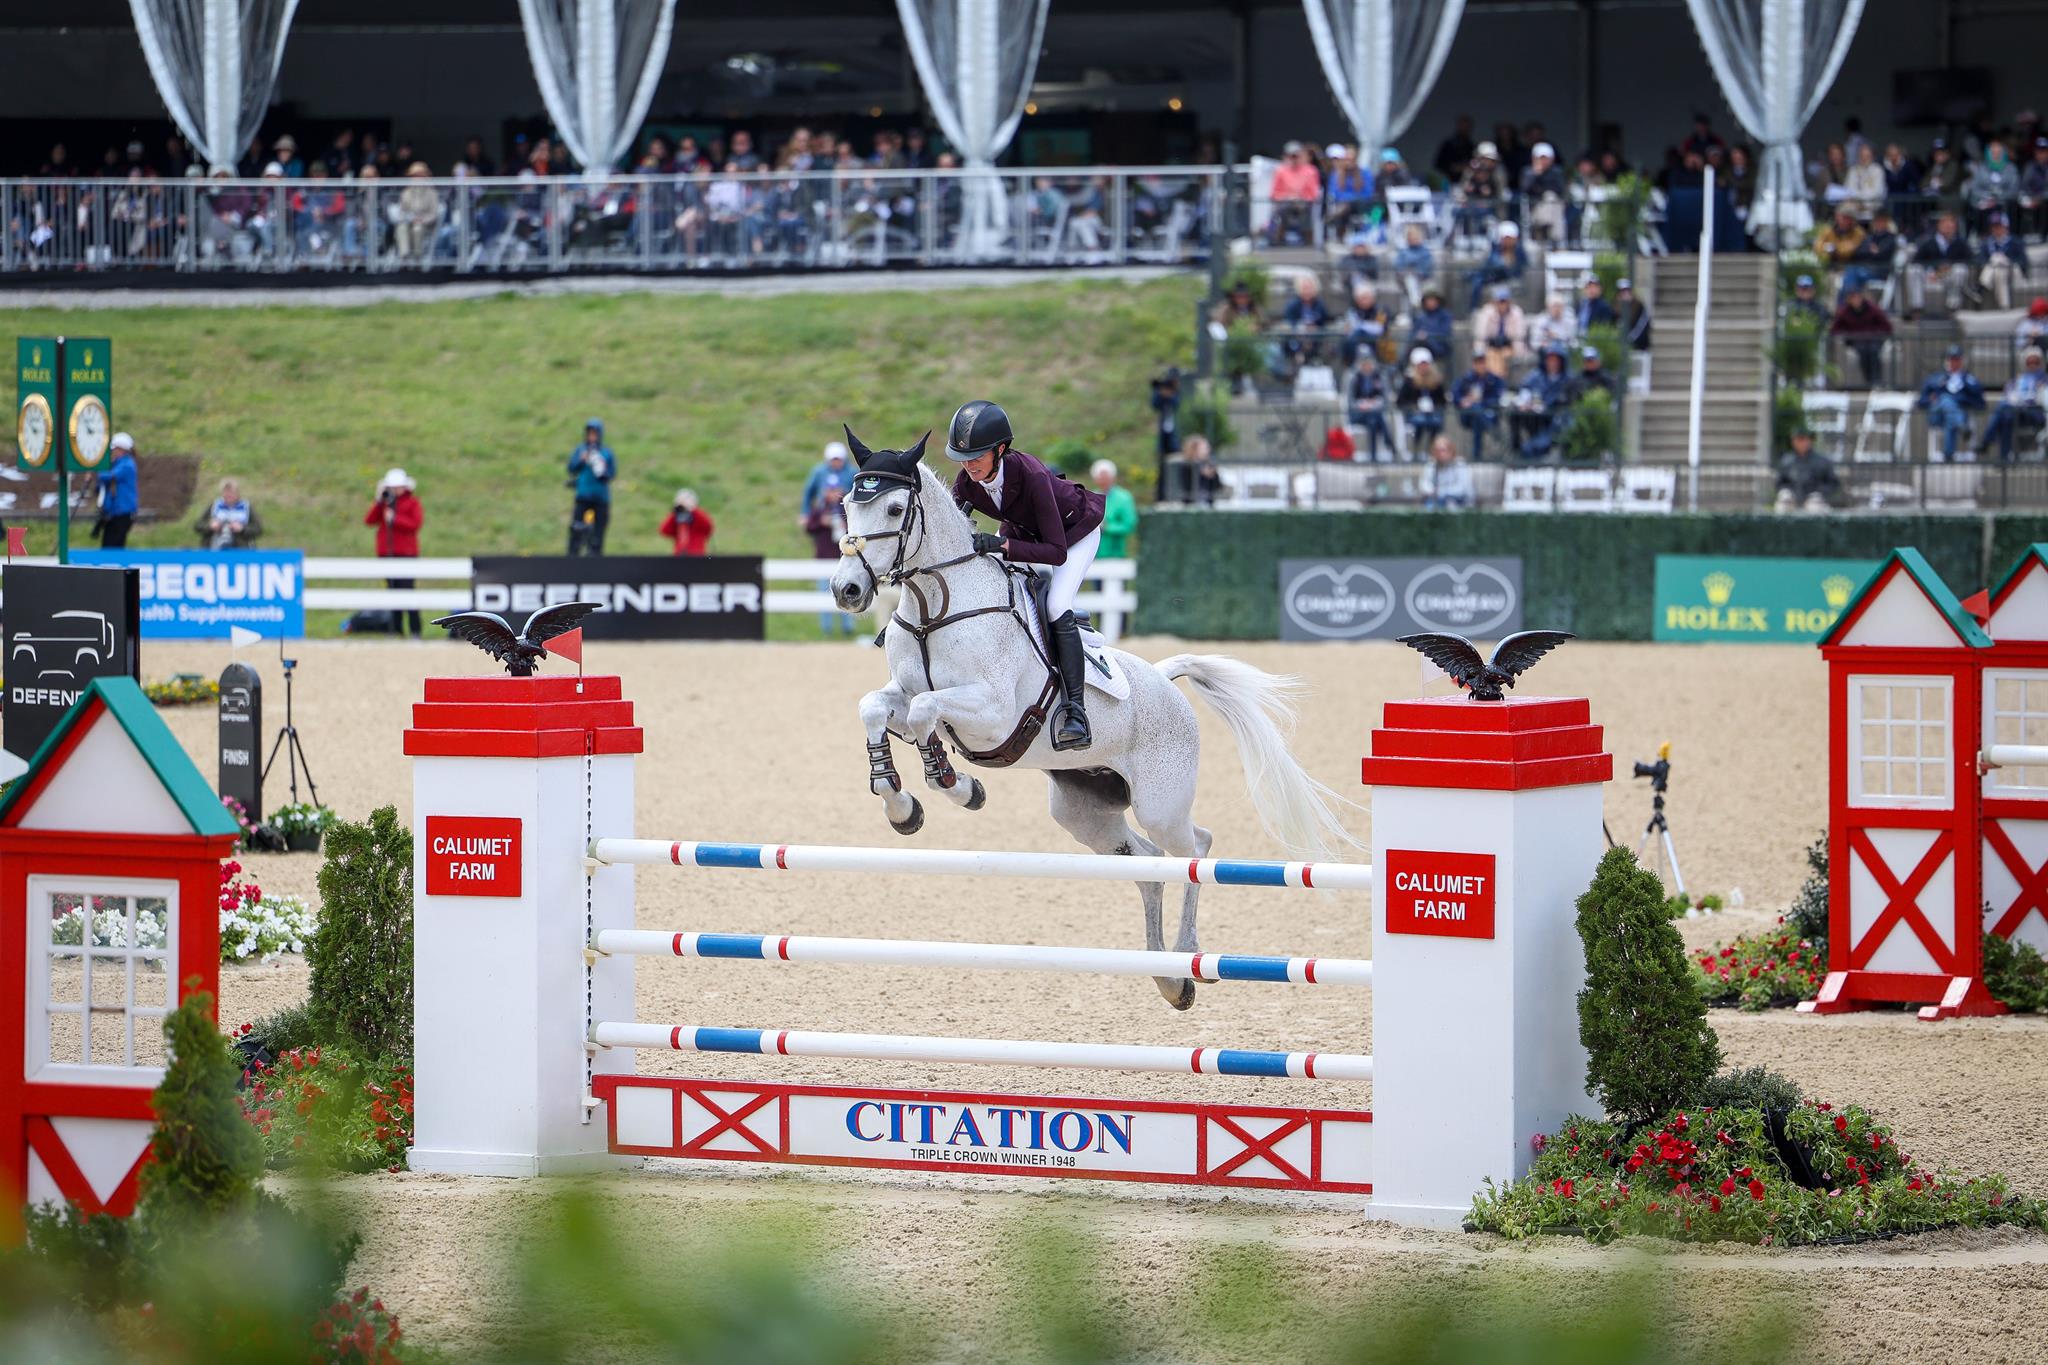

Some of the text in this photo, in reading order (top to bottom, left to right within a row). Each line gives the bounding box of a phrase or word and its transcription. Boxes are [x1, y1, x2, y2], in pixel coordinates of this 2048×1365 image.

[128, 563, 296, 603] SEQUIN
[474, 583, 761, 612] DEFENDER
[178, 603, 285, 624] Supplements
[1666, 605, 1769, 632] ROLEX
[223, 748, 249, 765] FINISH
[433, 836, 512, 856] CALUMET
[450, 862, 495, 880] FARM
[1395, 871, 1486, 895] CALUMET
[1414, 899, 1466, 921] FARM
[845, 1100, 1136, 1155] CITATION
[911, 1148, 1076, 1167] TRIPLE CROWN WINNER 1948
